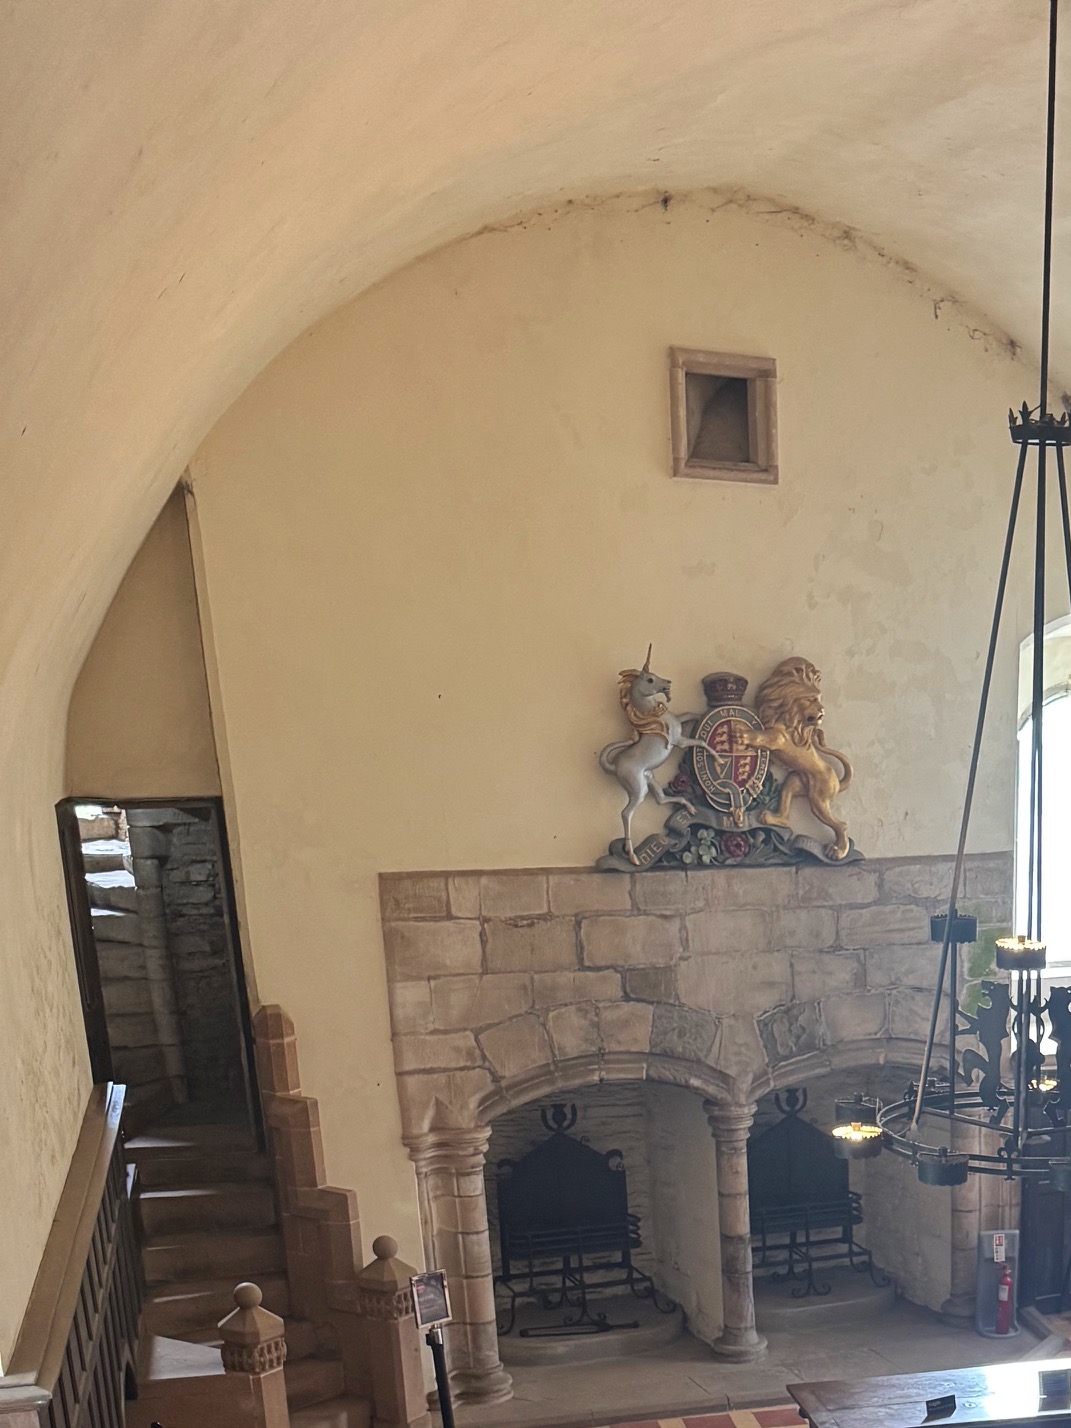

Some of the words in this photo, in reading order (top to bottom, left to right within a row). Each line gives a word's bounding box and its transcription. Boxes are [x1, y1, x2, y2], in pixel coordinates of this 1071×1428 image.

[720, 709, 740, 717] MAL
[700, 720, 713, 740] QUI
[700, 770, 716, 793] HONI
[640, 838, 668, 865] DIEU
[676, 811, 691, 825] ET
